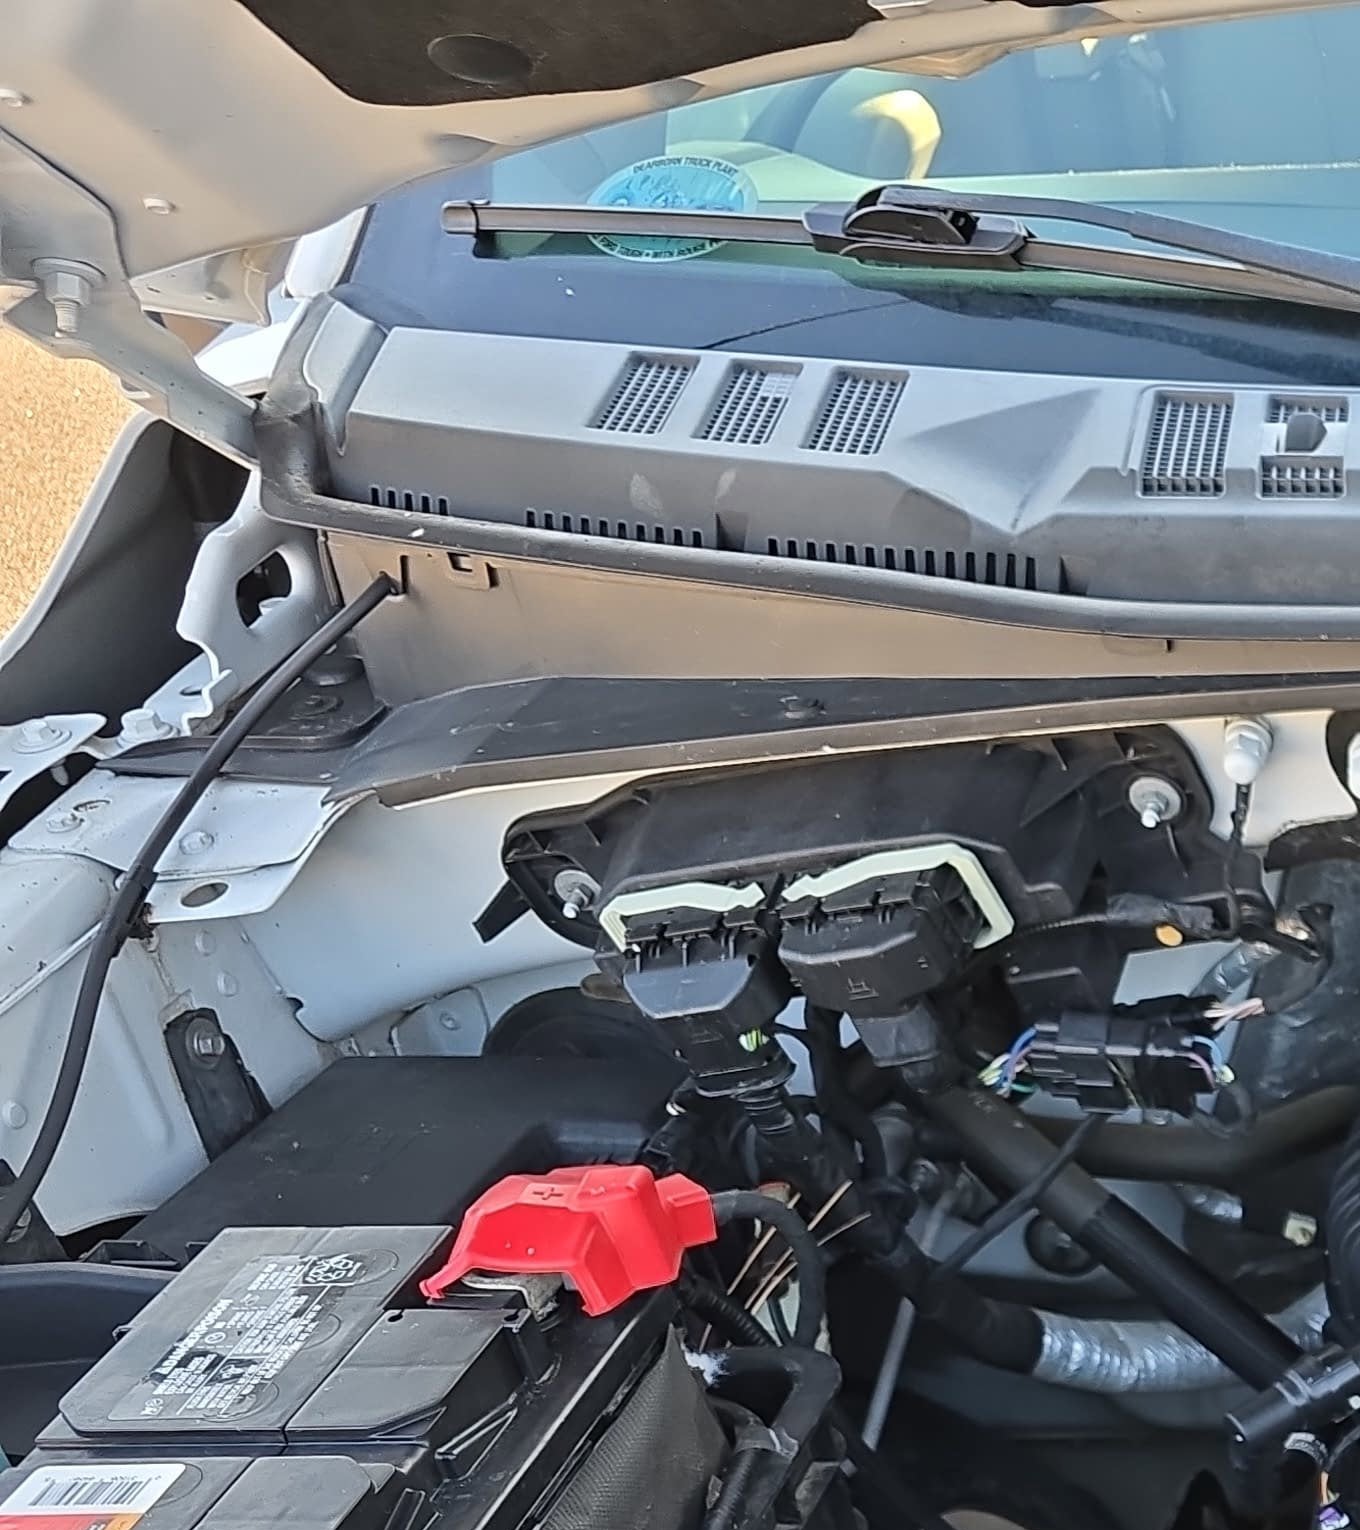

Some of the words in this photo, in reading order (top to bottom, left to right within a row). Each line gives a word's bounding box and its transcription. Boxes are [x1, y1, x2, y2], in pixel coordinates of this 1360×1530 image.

[633, 157, 681, 174] DEARBORN
[684, 156, 713, 168] TRUCK
[712, 160, 739, 178] PLANT
